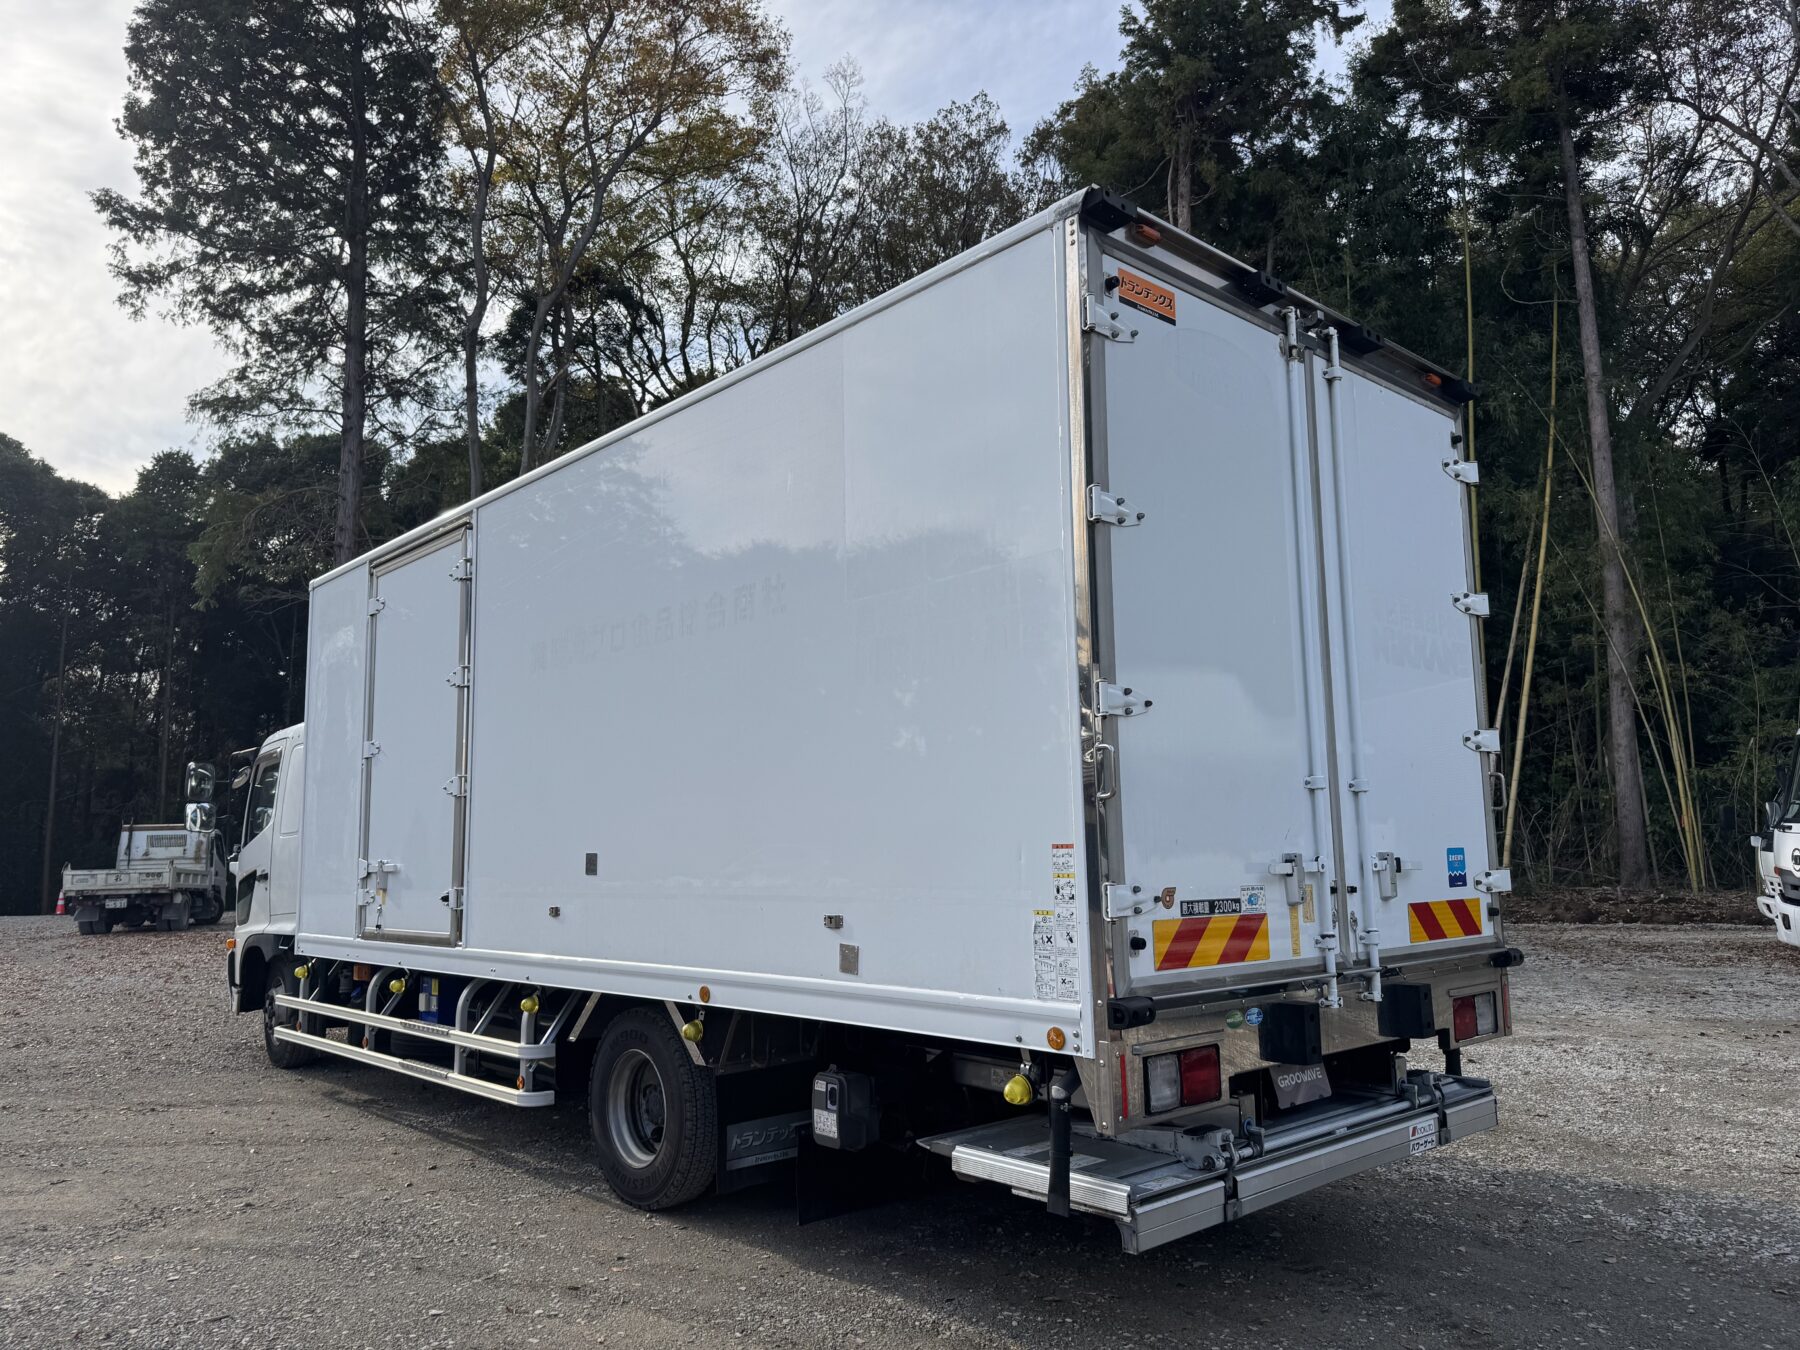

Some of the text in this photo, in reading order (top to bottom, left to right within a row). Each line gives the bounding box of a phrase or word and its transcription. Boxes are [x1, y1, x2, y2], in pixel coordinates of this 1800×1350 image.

[1120, 276, 1172, 310] トランテックス
[1182, 901, 1210, 915] 最大積載量
[1214, 899, 1240, 914] 2300kg
[1277, 1067, 1323, 1088] GROOWAVE
[1410, 1137, 1435, 1152] パワーゲート
